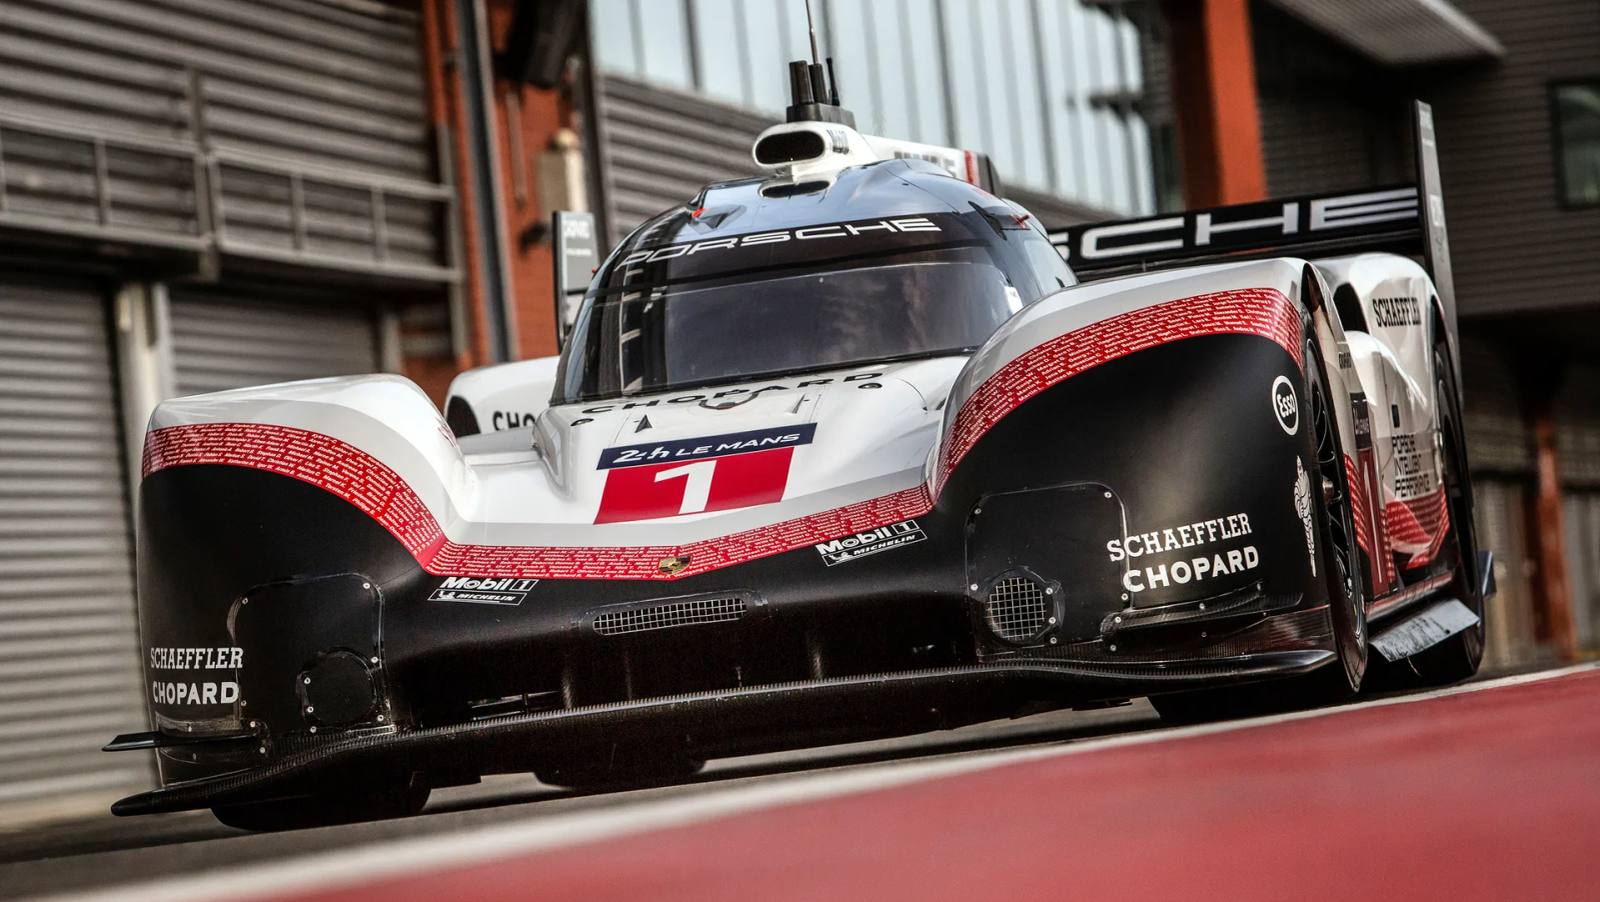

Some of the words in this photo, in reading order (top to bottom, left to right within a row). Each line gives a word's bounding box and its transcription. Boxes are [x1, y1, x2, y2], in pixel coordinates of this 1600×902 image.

[1049, 187, 1418, 262] CHE
[615, 217, 942, 272] PORSCHE
[583, 373, 882, 413] CHOPARD
[1276, 393, 1297, 419] Esso
[675, 446, 710, 456] LE
[715, 433, 800, 451] MANS
[654, 460, 717, 514] 1
[815, 526, 892, 555] Mobil
[854, 535, 916, 555] MICHELIN
[1106, 513, 1253, 562] SCHAEFFLER
[1122, 545, 1260, 593] CHOPARD
[439, 576, 514, 591] Mobil
[456, 593, 517, 601] MICHELIN
[150, 647, 244, 669] SCHAEFFLER
[152, 680, 240, 705] CHOPARD
